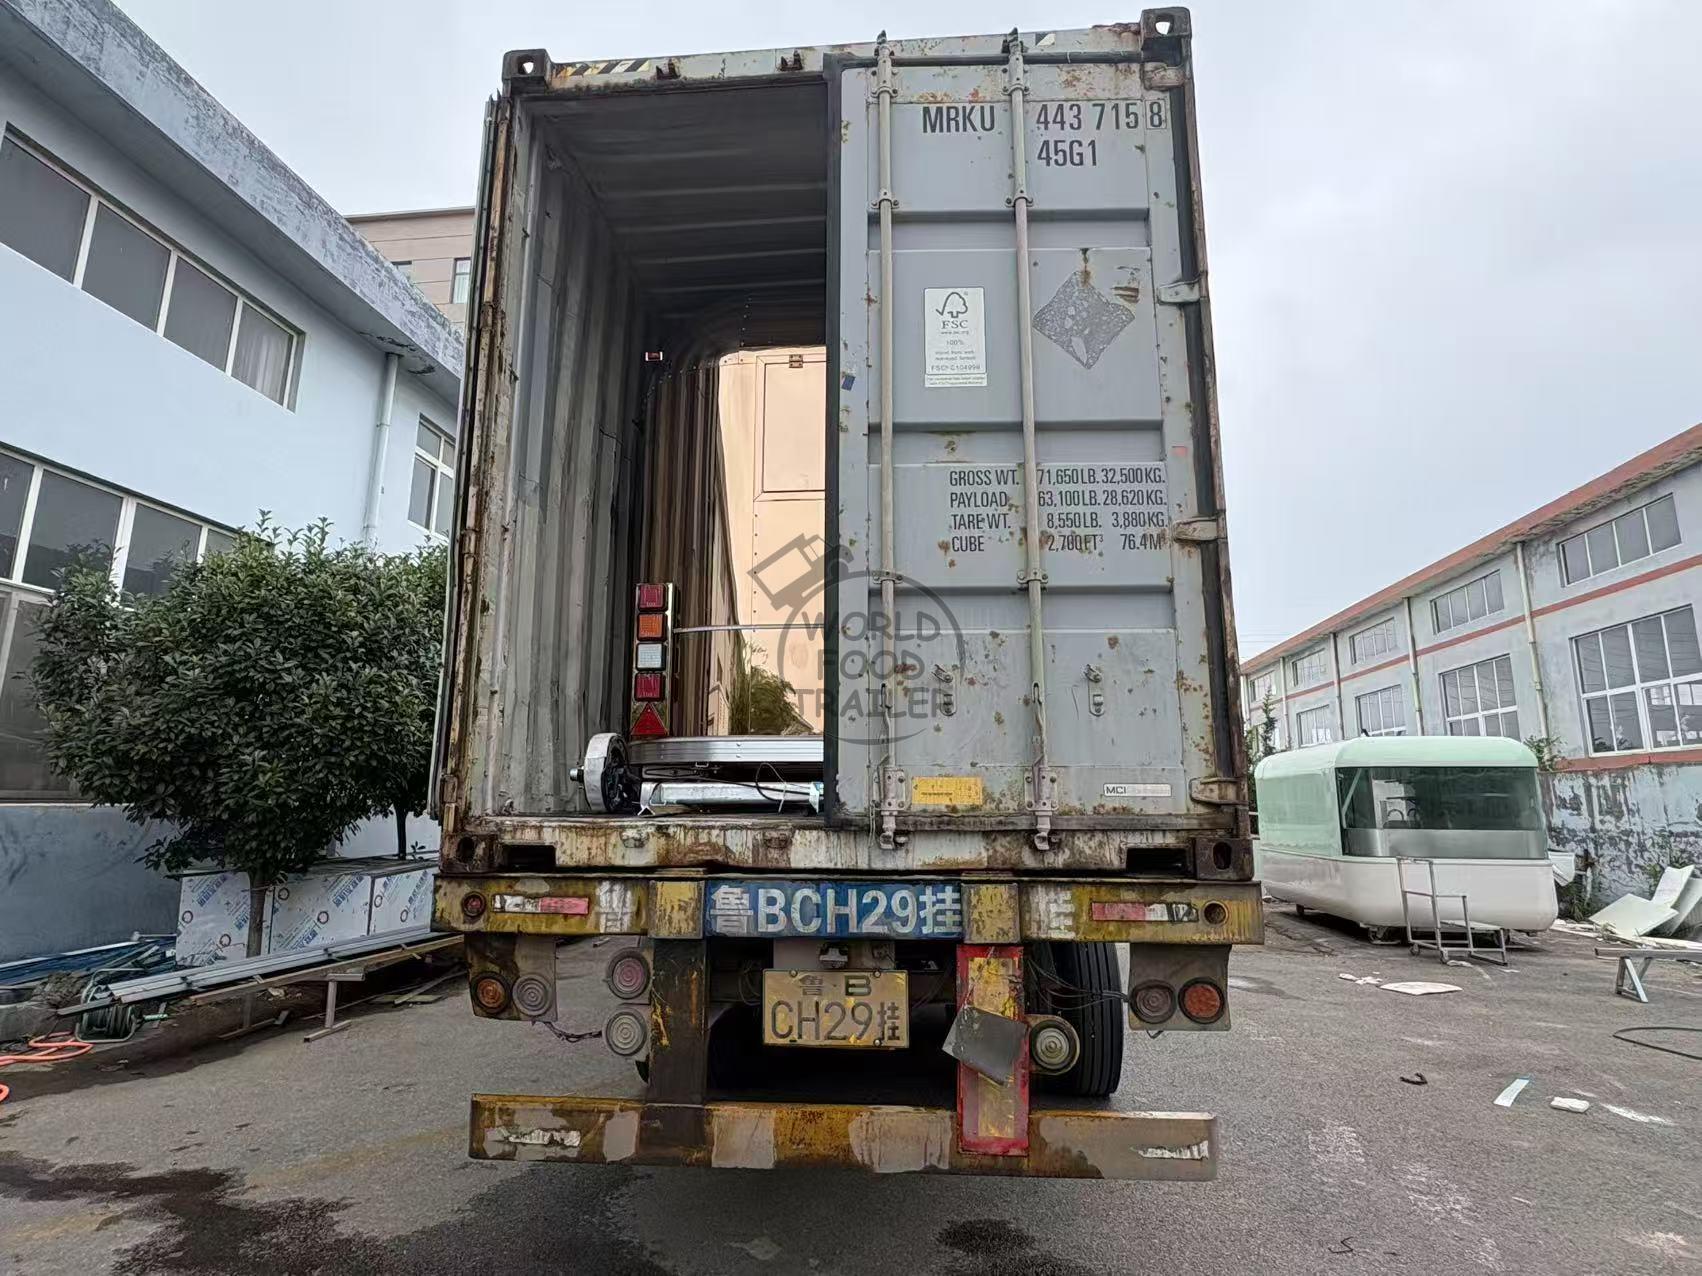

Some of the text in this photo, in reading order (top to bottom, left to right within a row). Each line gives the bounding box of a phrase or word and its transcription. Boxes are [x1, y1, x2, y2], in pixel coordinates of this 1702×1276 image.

[922, 101, 1164, 133] MRKU 443 715 8
[1037, 139, 1097, 167] 45G1
[941, 320, 969, 329] FSC
[949, 467, 1166, 486] GROSS WT. 71,650 LB. 32,500 KG.
[950, 489, 1167, 508] PAYLOAD 63,100 LB. 28,620 KG.
[951, 511, 1168, 530] TARE WT. 8,550 LB. 3,880 KG.
[952, 535, 985, 552] CUBE
[1120, 534, 1147, 550] 76.4
[1106, 786, 1127, 795] MCI
[709, 884, 963, 936] 鲁BCH29挂
[771, 1000, 901, 1042] CH29挂
